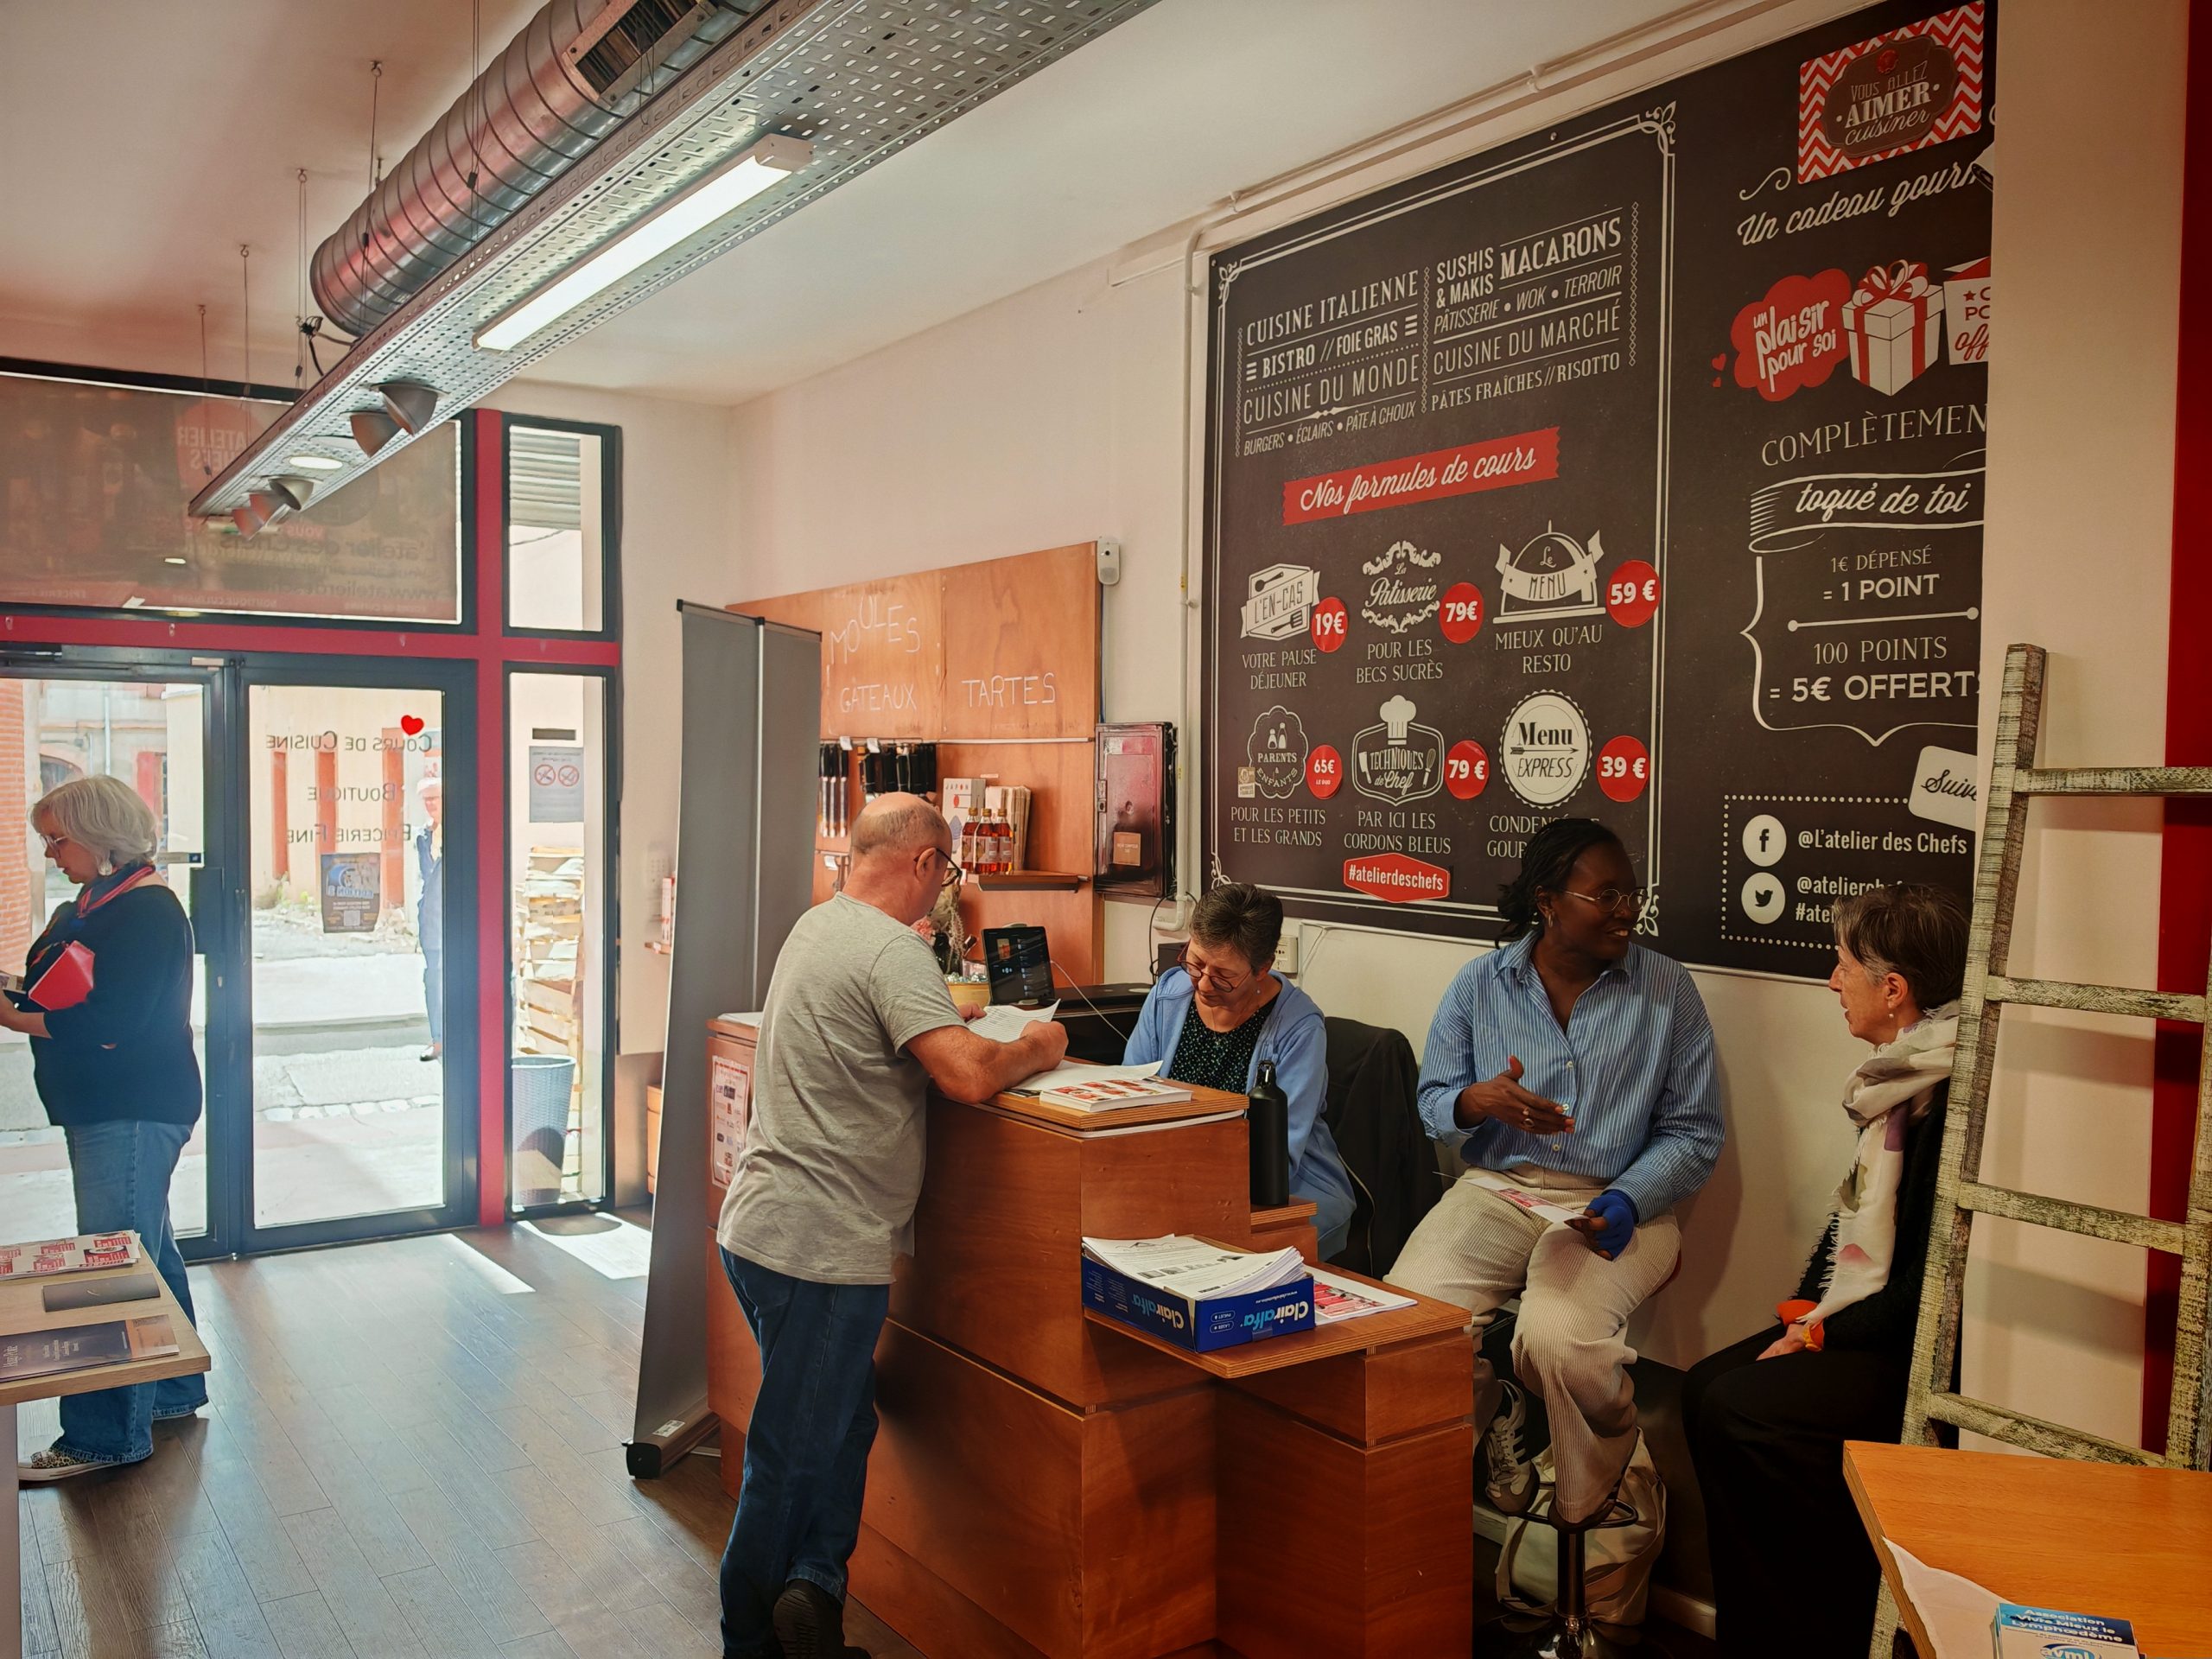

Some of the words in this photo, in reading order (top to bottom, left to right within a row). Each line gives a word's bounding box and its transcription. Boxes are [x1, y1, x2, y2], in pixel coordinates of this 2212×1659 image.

[1852, 82, 1879, 102] VOUS
[1888, 60, 1928, 91] ALLEZ
[1845, 82, 1931, 128] AIMER
[1846, 109, 1929, 145] cuisiner
[1738, 212, 1779, 246] Un
[1785, 188, 1885, 234] cadeau
[1437, 247, 1493, 283] SUSHIS
[1500, 217, 1621, 279] MACARONS
[1434, 299, 1500, 334] PÂTISSERIE
[1517, 286, 1547, 312] WOK
[1565, 265, 1622, 298] TERROIR
[1437, 288, 1446, 308] &
[1451, 274, 1493, 305] MAKIS
[1247, 300, 1313, 346] CUISINE
[1320, 270, 1418, 324] ITALIENNE
[1753, 311, 1767, 329] un
[1262, 344, 1315, 378] BISTRO
[1365, 321, 1397, 348] GRAS
[1433, 336, 1502, 375] CUISINE
[1509, 329, 1533, 353] DU
[1541, 299, 1620, 348] MARCHÉ
[1755, 301, 1829, 379] plaisir
[1767, 341, 1808, 392] pour
[1813, 329, 1836, 358] soi
[1243, 383, 1312, 424] CUISINE
[1320, 374, 1343, 405] DU
[1353, 354, 1419, 397] MONDE
[1432, 387, 1471, 411] PÂTES
[1244, 433, 1285, 455] BURGERS
[1296, 420, 1333, 444] ÉCLAIRS
[1345, 410, 1369, 432] PÂTE
[1370, 406, 1376, 427] À
[1378, 401, 1416, 425] CHOUX
[1300, 478, 1344, 512] Nos
[1343, 463, 1437, 514] formules
[1440, 454, 1468, 485] de
[1473, 447, 1536, 477] cours
[1796, 482, 1878, 522] toqué
[1879, 485, 1920, 514] de
[1924, 483, 1972, 514] toi
[1395, 563, 1407, 575] La
[1539, 545, 1554, 568] Le
[1831, 556, 1848, 573] 1€
[1857, 544, 1933, 571] DÉPENSÉ
[1528, 571, 1567, 600] MENU
[1842, 582, 1849, 601] 1
[1859, 574, 1940, 600] POINT
[1254, 582, 1304, 625] L'EN-CAS
[1445, 601, 1478, 623] 79€
[830, 595, 920, 664] MOULES
[1314, 610, 1345, 637] 19€
[1367, 641, 1403, 660] POUR
[1408, 639, 1432, 658] LES
[1495, 627, 1543, 650] MIEUX
[1553, 625, 1603, 646] QU'AU
[1814, 642, 1848, 664] 100
[1860, 636, 1948, 663] POINTS
[1242, 652, 1276, 669] VOTRE
[1281, 648, 1317, 667] PAUSE
[1356, 664, 1387, 683] BECS
[1393, 659, 1443, 681] SUCRÈS
[1522, 653, 1571, 674] RESTO
[962, 672, 1056, 708] TARTES
[1250, 670, 1306, 690] DÉJEUNER
[1791, 676, 1832, 702] 5€
[1517, 721, 1573, 746] Menu
[1257, 752, 1297, 764] PARENTS
[1313, 760, 1335, 774] 65€
[1370, 747, 1424, 770] TECHNIQUES
[1517, 757, 1574, 779] EXPRESS
[1256, 767, 1298, 787] ENFANTS
[1374, 775, 1384, 785] de
[1384, 770, 1414, 795] Chef
[1230, 806, 1260, 823] POUR
[1264, 807, 1285, 823] LES
[1288, 808, 1325, 825] PETITS
[1357, 810, 1384, 828] PAR
[1389, 811, 1407, 829] ICI
[1411, 812, 1436, 830] LES
[1234, 828, 1248, 842] ET
[1251, 828, 1273, 844] LES
[1275, 830, 1322, 847] GRANDS
[1344, 833, 1403, 852] CORDONS
[1408, 836, 1451, 855] BLEUS
[1798, 830, 1878, 850] @L'atelier
[1883, 832, 1912, 852] des
[1917, 833, 1967, 854] Chefs
[1349, 863, 1443, 892] #atelierdeschefs
[1132, 1294, 1184, 1329] Clairalfa
[1243, 1300, 1309, 1331] Clairalfa
[2024, 1609, 2105, 1626] Association
[2056, 1619, 2100, 1633] Mieux
